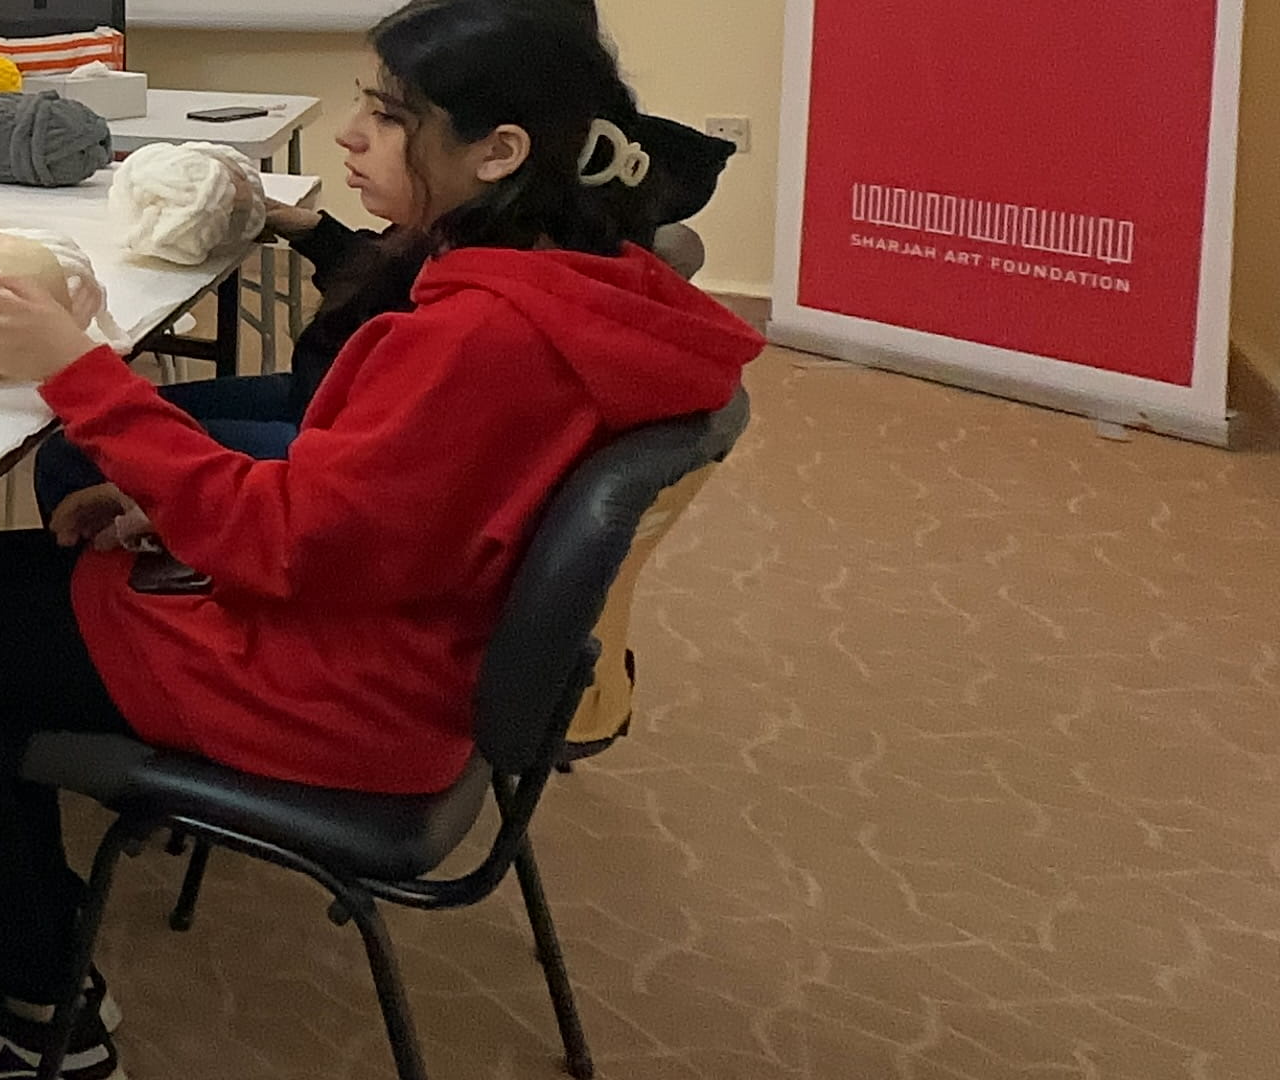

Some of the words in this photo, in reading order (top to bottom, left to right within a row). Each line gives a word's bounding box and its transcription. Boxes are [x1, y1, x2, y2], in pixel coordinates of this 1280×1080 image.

[850, 232, 937, 260] SHARJAH
[943, 248, 983, 268] ART
[989, 255, 1131, 294] FOUNDATION
